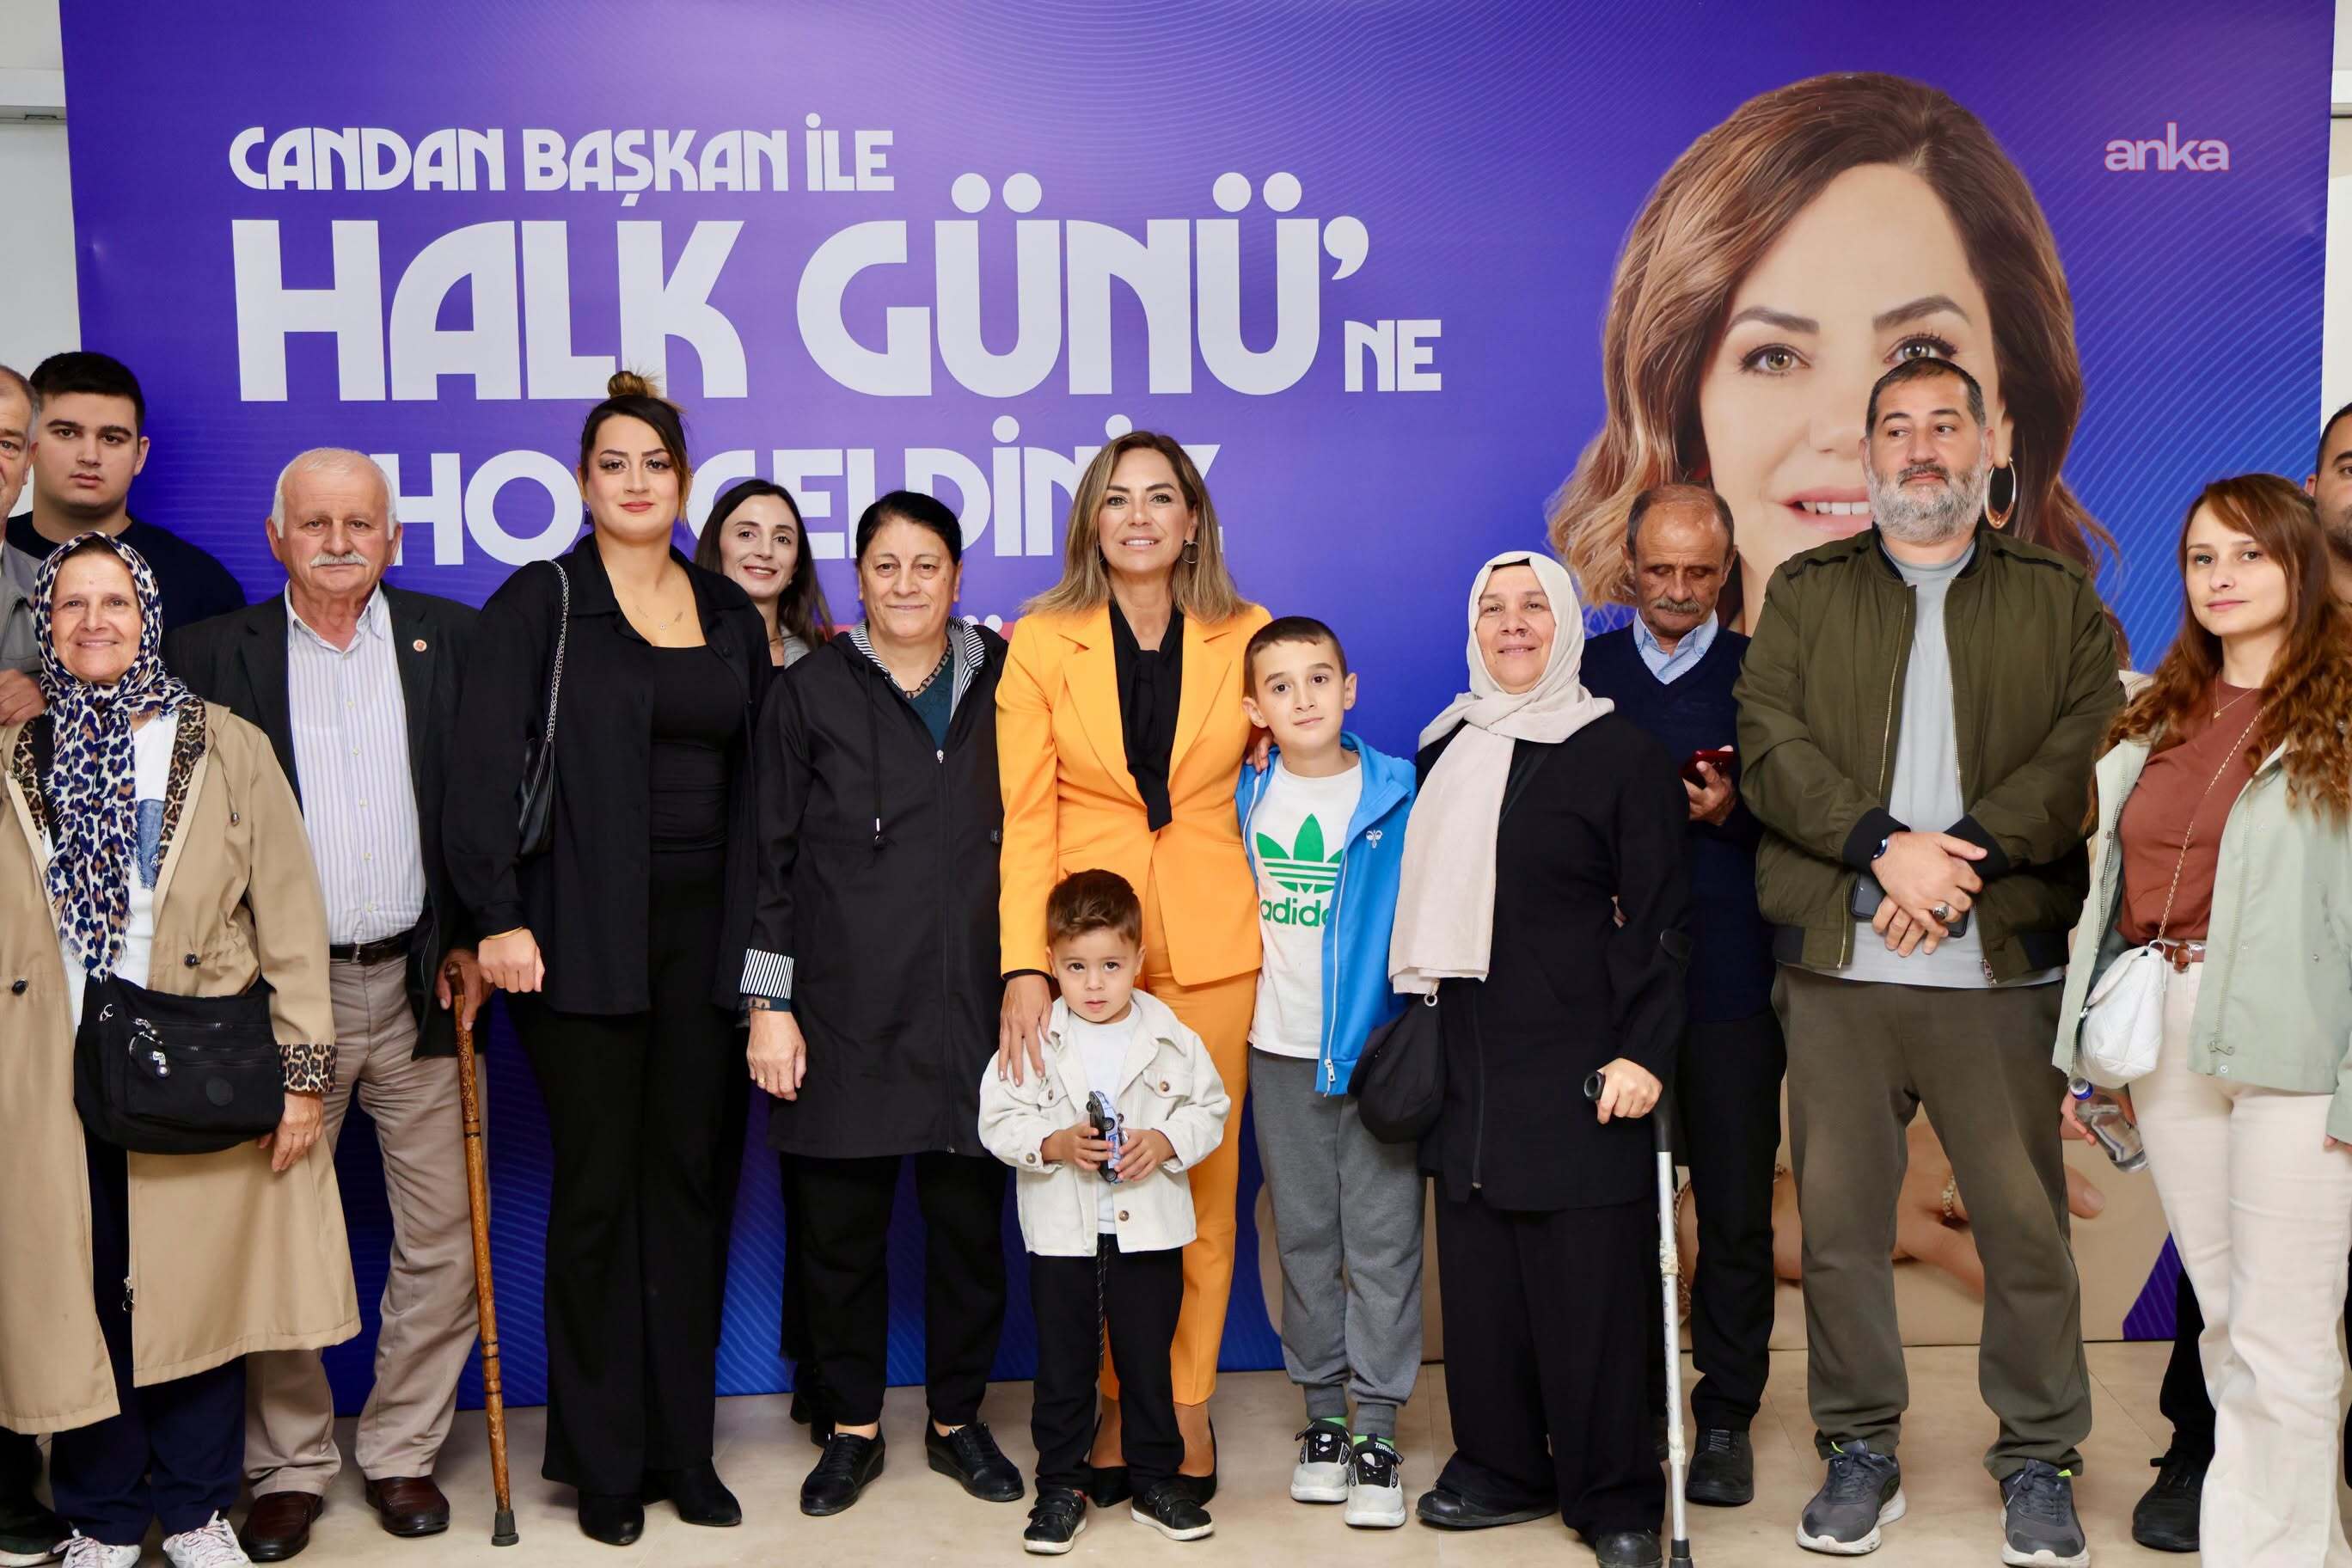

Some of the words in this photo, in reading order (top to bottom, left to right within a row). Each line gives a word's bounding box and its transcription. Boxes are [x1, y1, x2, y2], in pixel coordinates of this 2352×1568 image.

[229, 126, 505, 192] CANDAN
[523, 128, 789, 206] BAŞKAN
[805, 113, 895, 192] İLE
[232, 220, 748, 401] HALK
[370, 449, 585, 567] HO
[1260, 897, 1330, 928] adid
